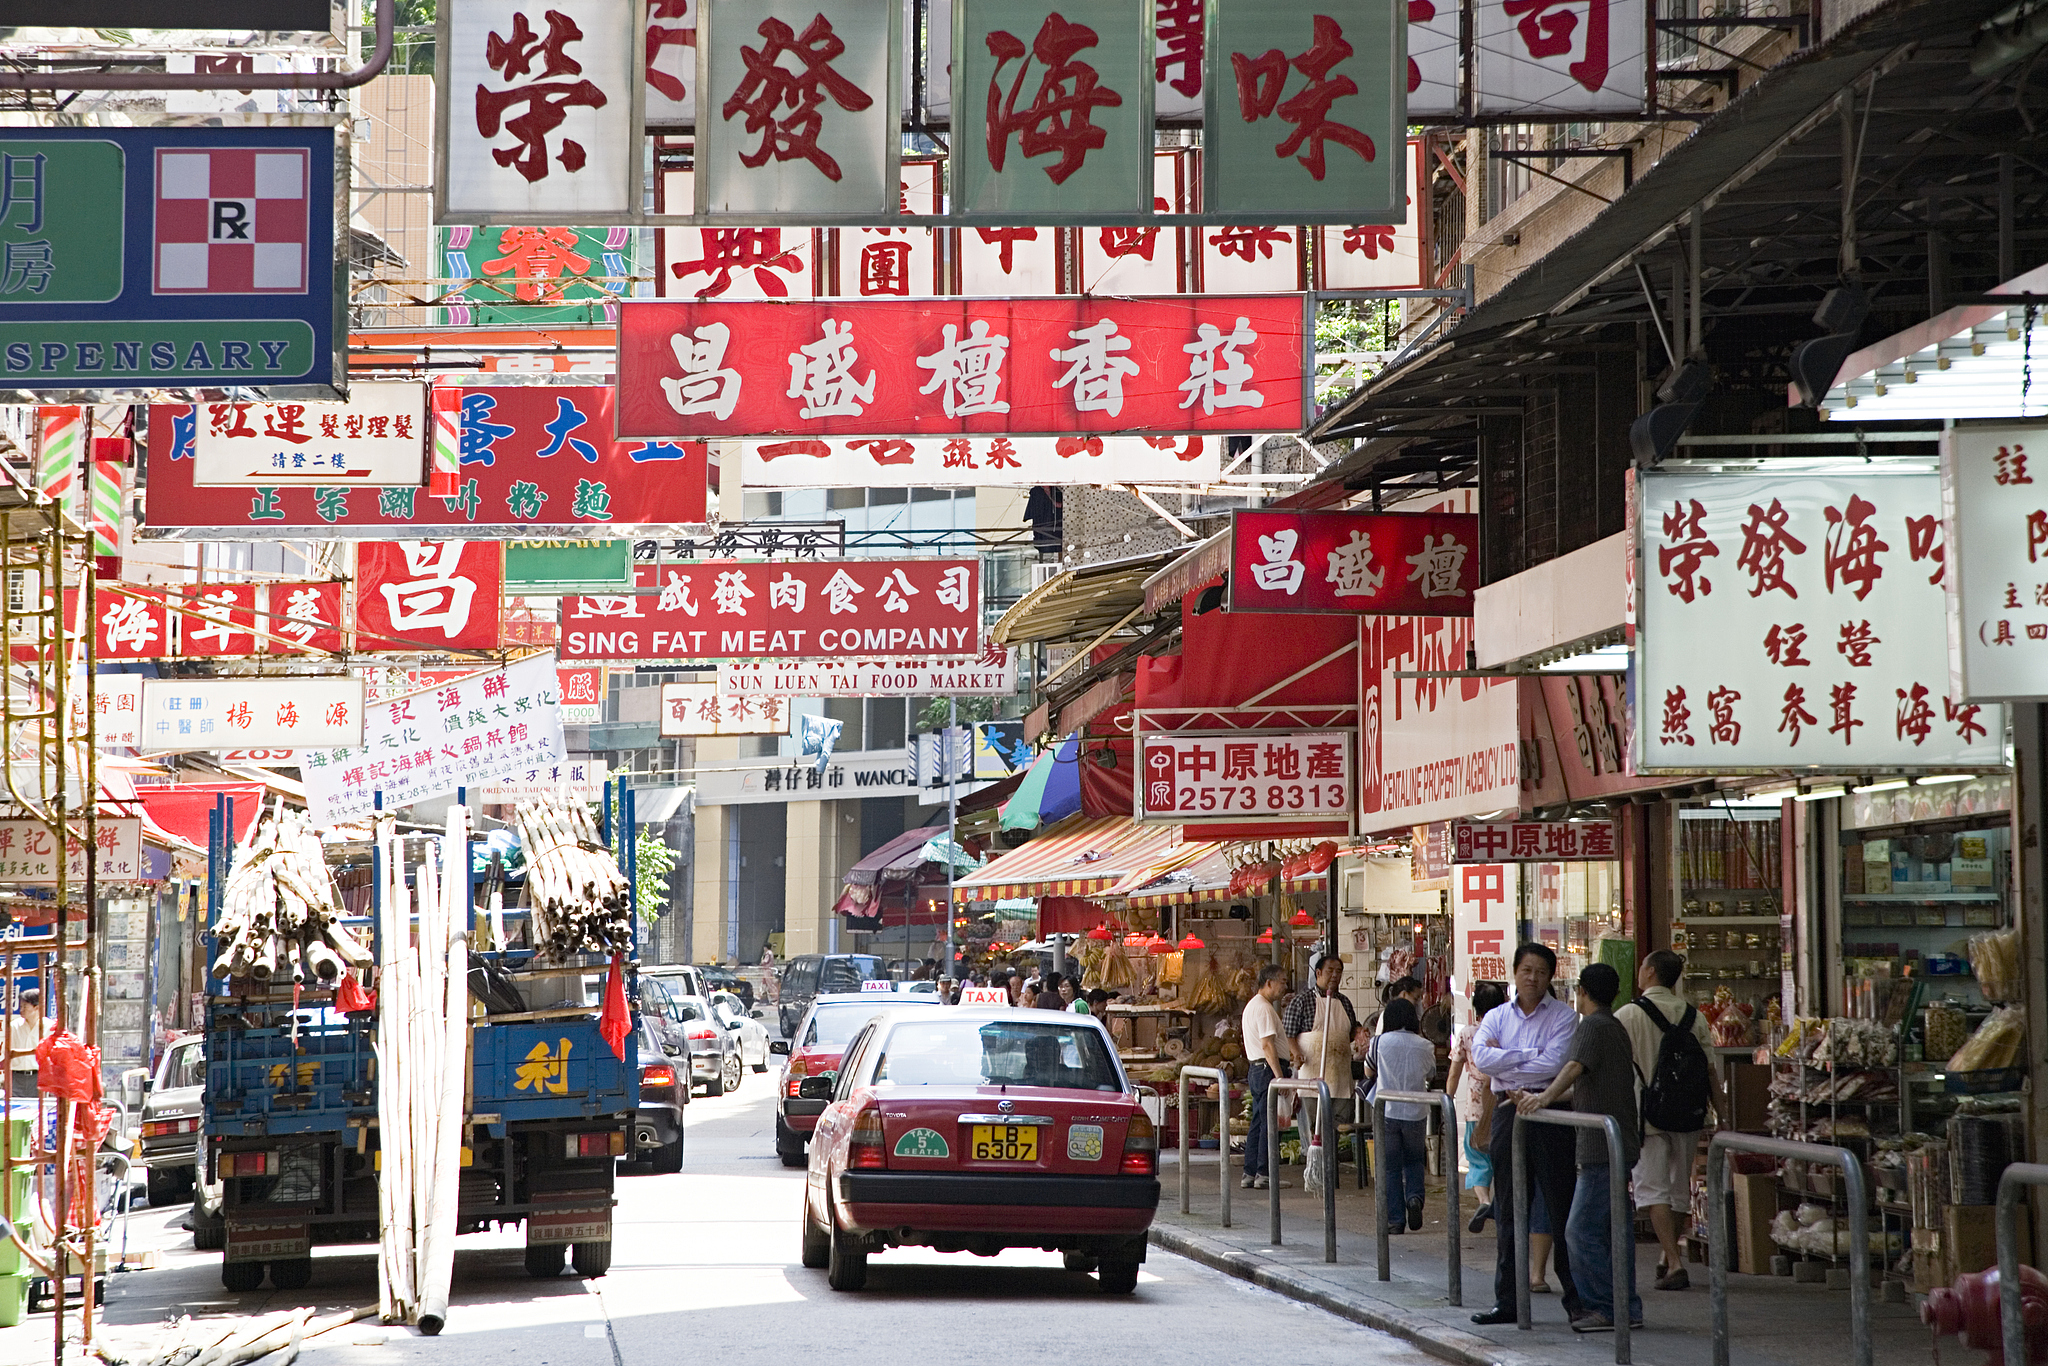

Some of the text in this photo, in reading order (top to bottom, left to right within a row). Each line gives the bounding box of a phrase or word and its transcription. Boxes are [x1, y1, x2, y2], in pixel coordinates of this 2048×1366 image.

[475, 10, 1376, 185] 榮發海味
[659, 317, 1265, 420] 昌盛檀香莊
[271, 452, 347, 469] 請登二樓
[1250, 526, 1468, 598] 昌盛檀
[567, 627, 970, 655] SING FAT MEAT COMPANY
[728, 672, 1005, 690] SUN LUEN TAI FOOD MARKET
[226, 700, 350, 729] 楊海源
[568, 707, 595, 718] FOOD
[666, 697, 784, 724] 百德水電
[156, 718, 215, 735] 中醫師
[1177, 741, 1345, 783] 中原地產
[1178, 784, 1345, 811] 2573 8313
[1473, 823, 1615, 858] 中原地產
[864, 981, 889, 991] TAXI
[965, 990, 1004, 1004] TAXI
[513, 1036, 573, 1095] 利
[909, 1130, 936, 1140] TAXI
[918, 1136, 927, 1149] 5
[990, 1126, 1018, 1143] LB
[904, 1147, 940, 1156] SEATS
[976, 1142, 1032, 1160] 6307
